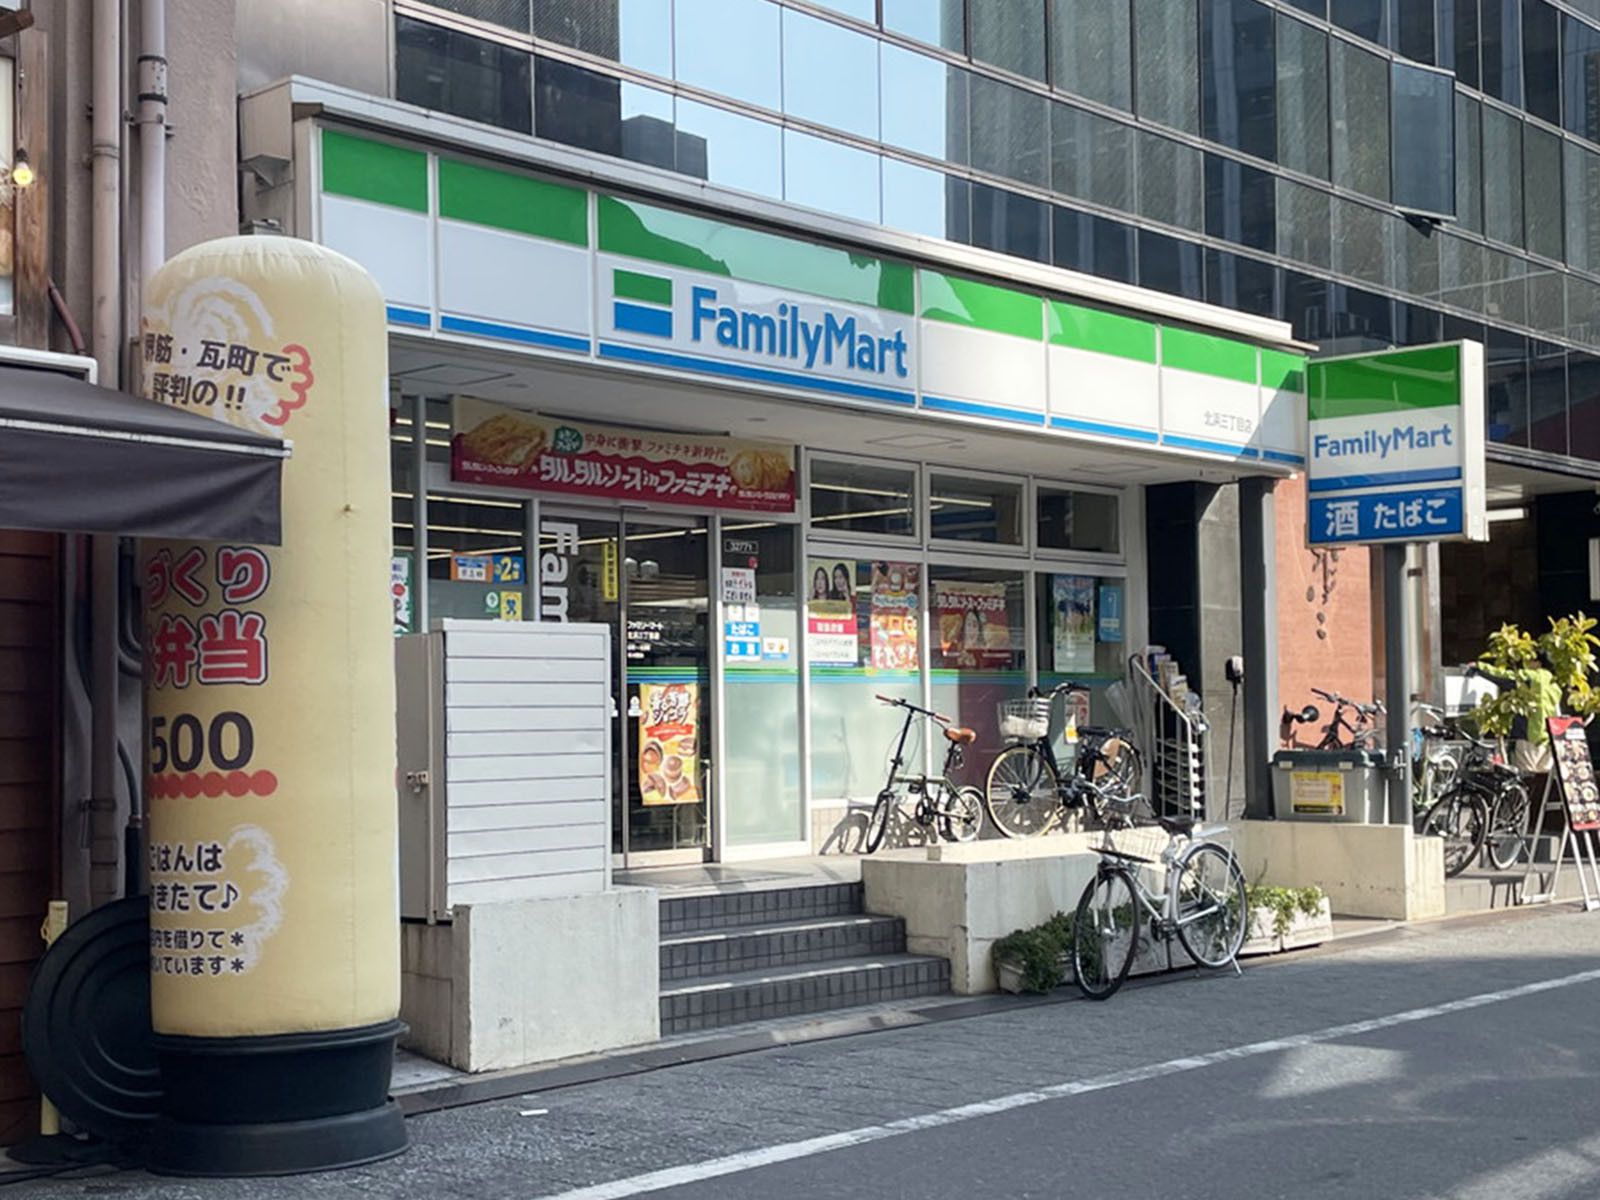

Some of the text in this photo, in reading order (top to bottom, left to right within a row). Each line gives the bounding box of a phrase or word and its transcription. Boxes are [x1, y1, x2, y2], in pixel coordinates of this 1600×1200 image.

[692, 286, 907, 377] FamilyMart
[1313, 424, 1453, 458] FamilyMart
[540, 454, 733, 499] タルタルソースinファミチキ
[1326, 498, 1448, 536] 酒 たばこ
[154, 609, 268, 688] 弁当
[151, 883, 218, 911] きたて
